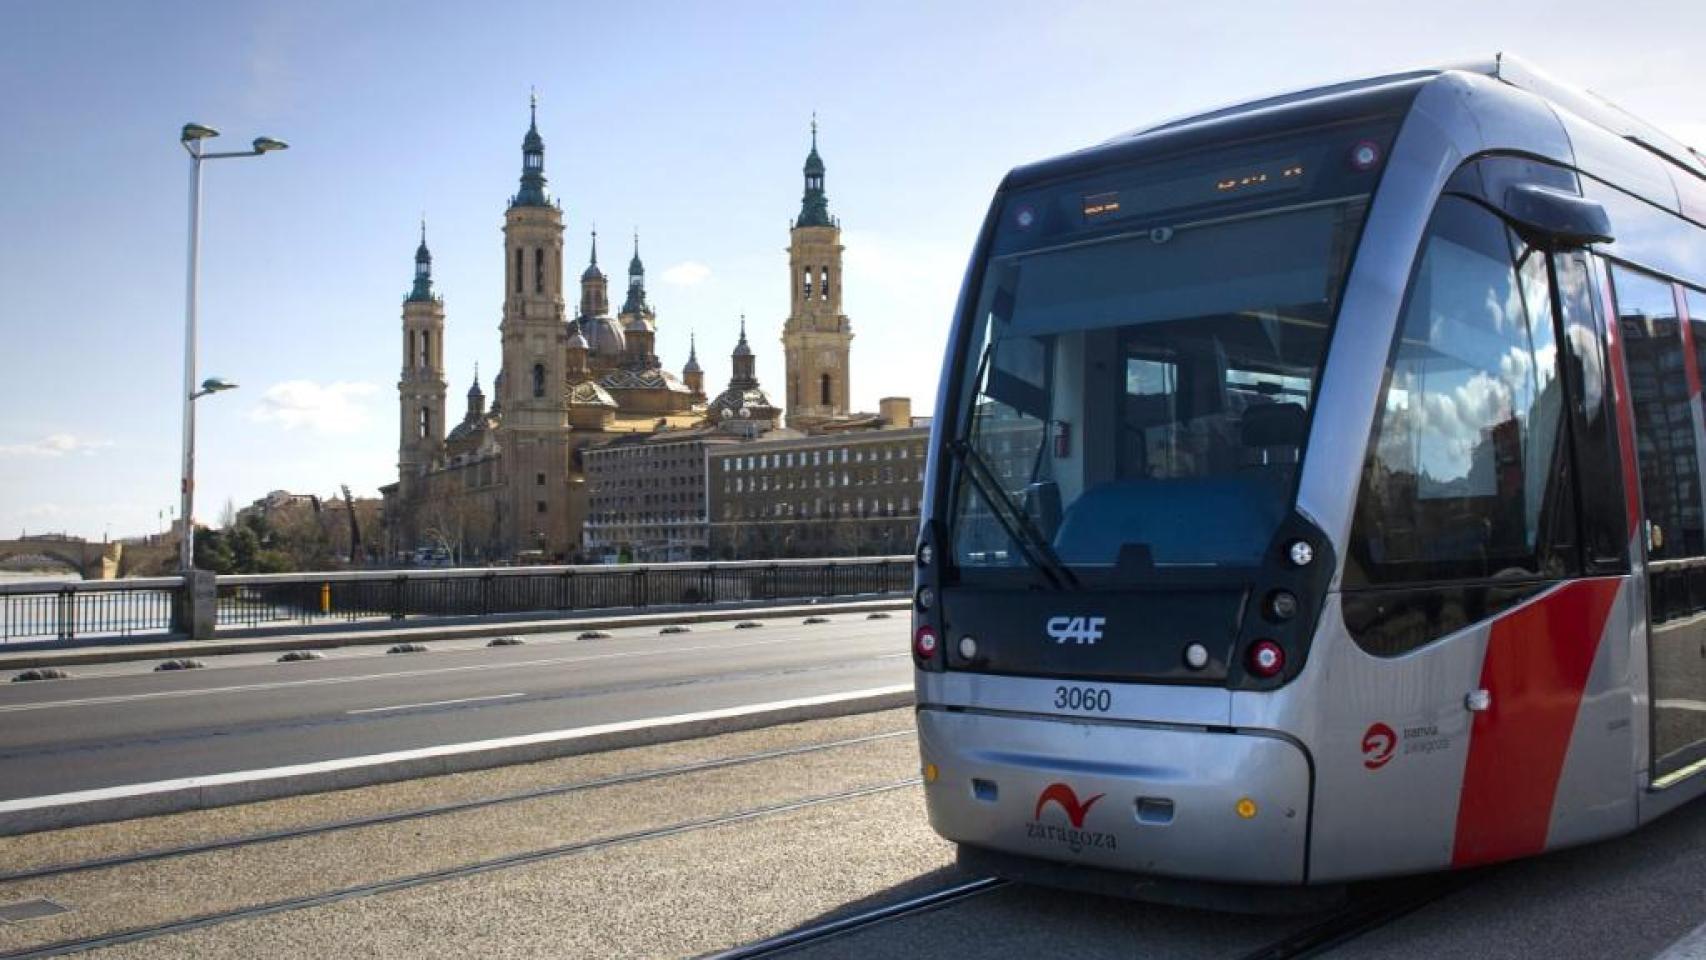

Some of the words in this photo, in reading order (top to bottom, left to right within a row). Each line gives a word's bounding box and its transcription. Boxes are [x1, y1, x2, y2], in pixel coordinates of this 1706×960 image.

[1047, 616, 1106, 644] CAF
[1054, 686, 1112, 712] 3060
[1025, 821, 1118, 854] zaragoza
